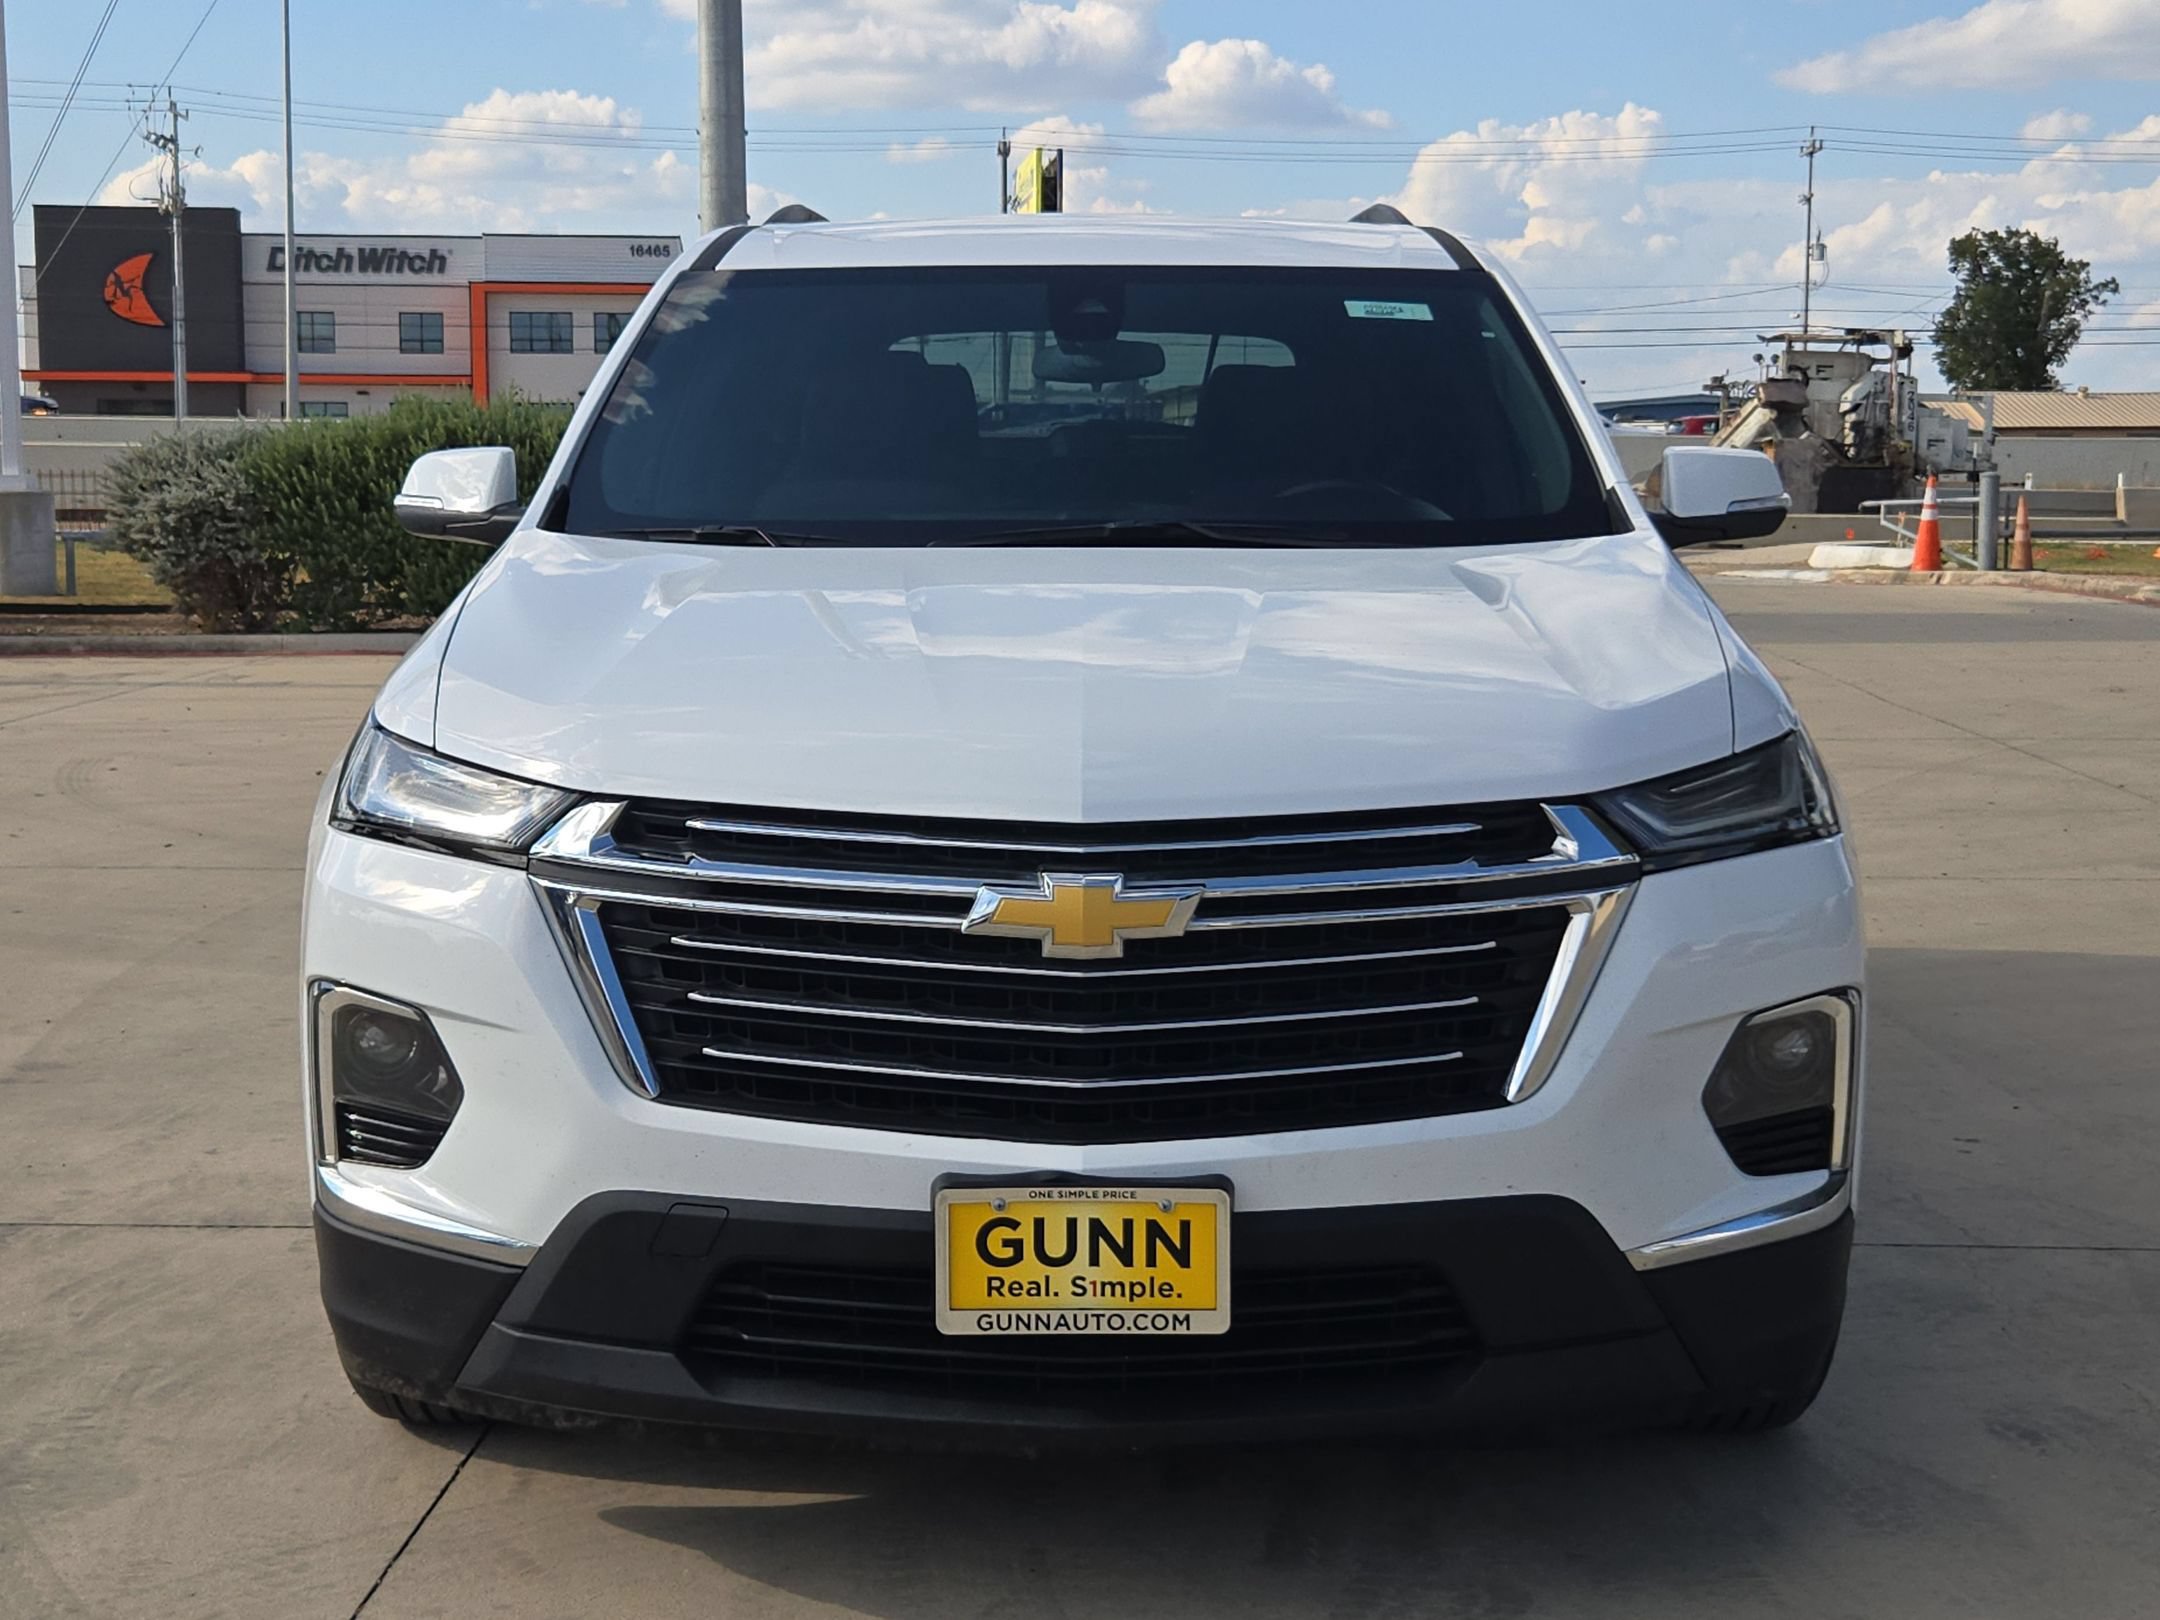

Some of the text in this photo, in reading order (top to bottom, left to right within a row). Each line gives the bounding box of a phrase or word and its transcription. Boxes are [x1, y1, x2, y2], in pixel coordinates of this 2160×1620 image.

[266, 246, 448, 274] Ditch Witch
[629, 244, 671, 258] 16465
[1028, 1190, 1138, 1200] ONE SIMPLE PRICE
[974, 1216, 1192, 1269] GUNN
[986, 1275, 1059, 1298] Real.
[976, 1313, 1191, 1332] GUNNAUTO.COM
